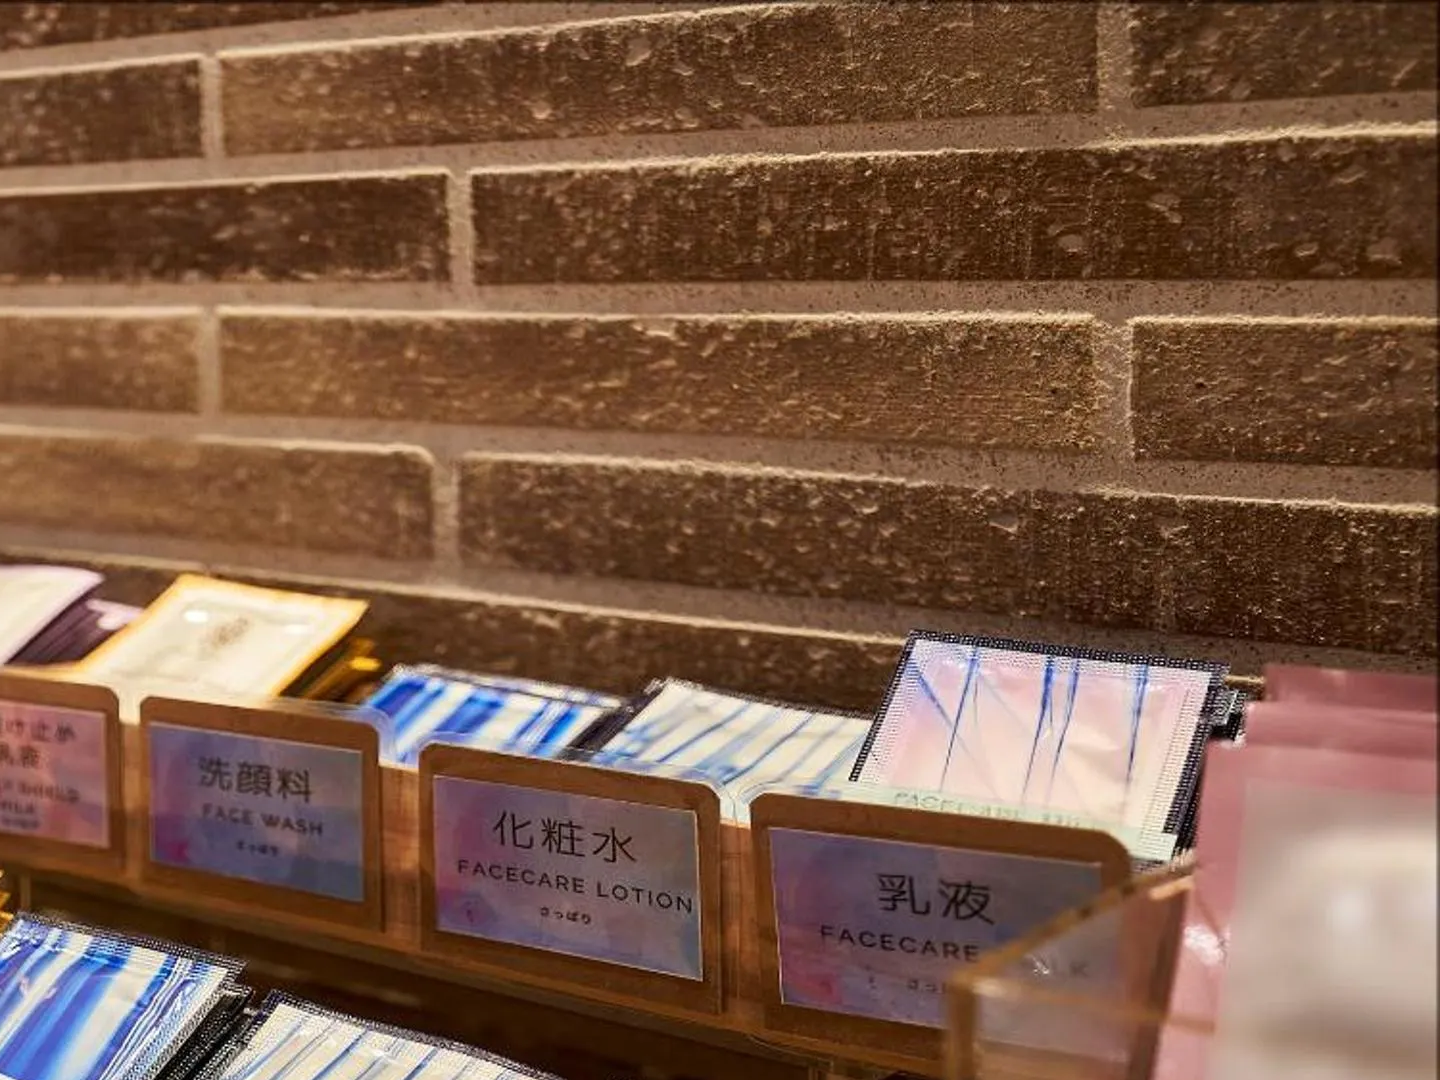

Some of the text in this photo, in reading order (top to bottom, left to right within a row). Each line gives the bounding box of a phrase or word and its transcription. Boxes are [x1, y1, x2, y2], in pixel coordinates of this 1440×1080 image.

[198, 756, 313, 803] 洗顔料
[202, 803, 323, 837] FACE WASH
[493, 810, 638, 863] 化粧水
[457, 859, 693, 914] FACECARE LOTION
[875, 873, 995, 926] 乳液
[820, 924, 980, 963] FACECARE
